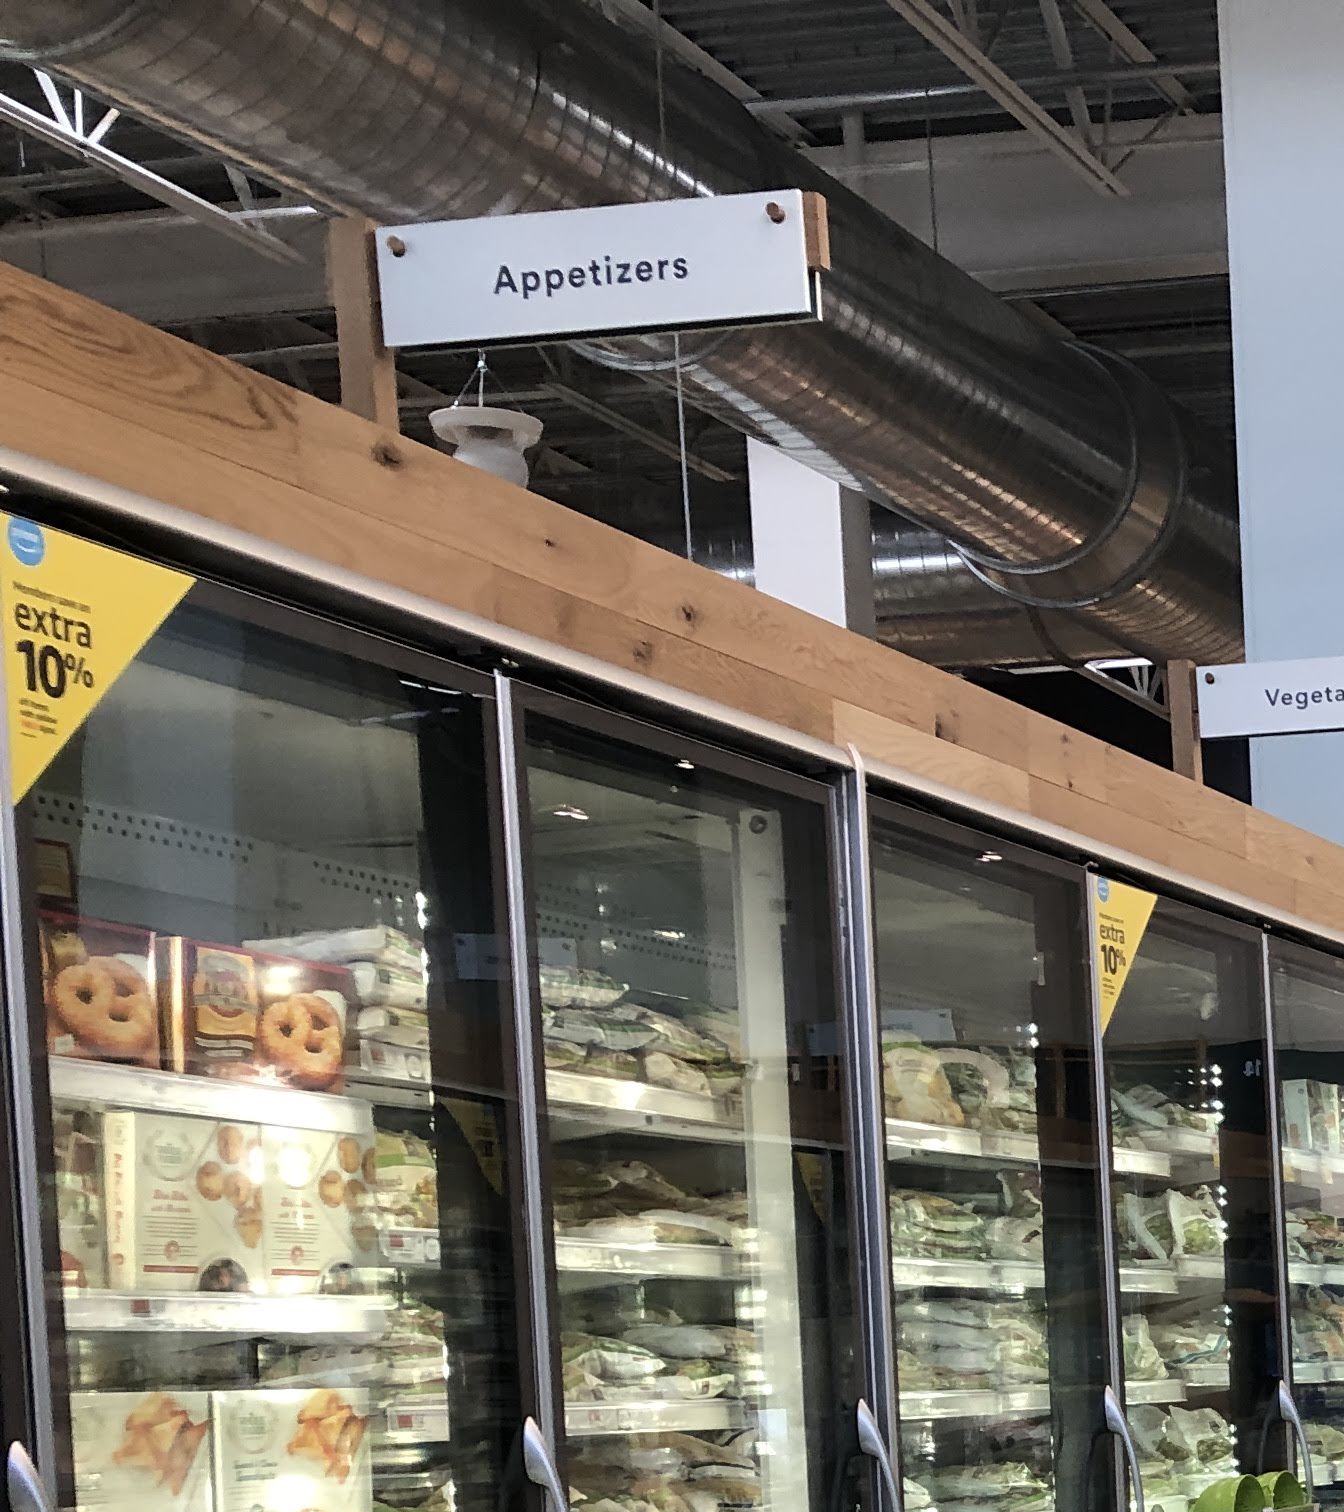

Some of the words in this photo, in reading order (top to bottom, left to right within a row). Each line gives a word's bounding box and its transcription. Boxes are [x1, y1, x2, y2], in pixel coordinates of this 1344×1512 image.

[493, 255, 689, 300] Appetizers
[14, 602, 92, 650] extra
[16, 639, 95, 698] 10%
[1100, 923, 1125, 945] extra
[1101, 943, 1127, 975] 10%
